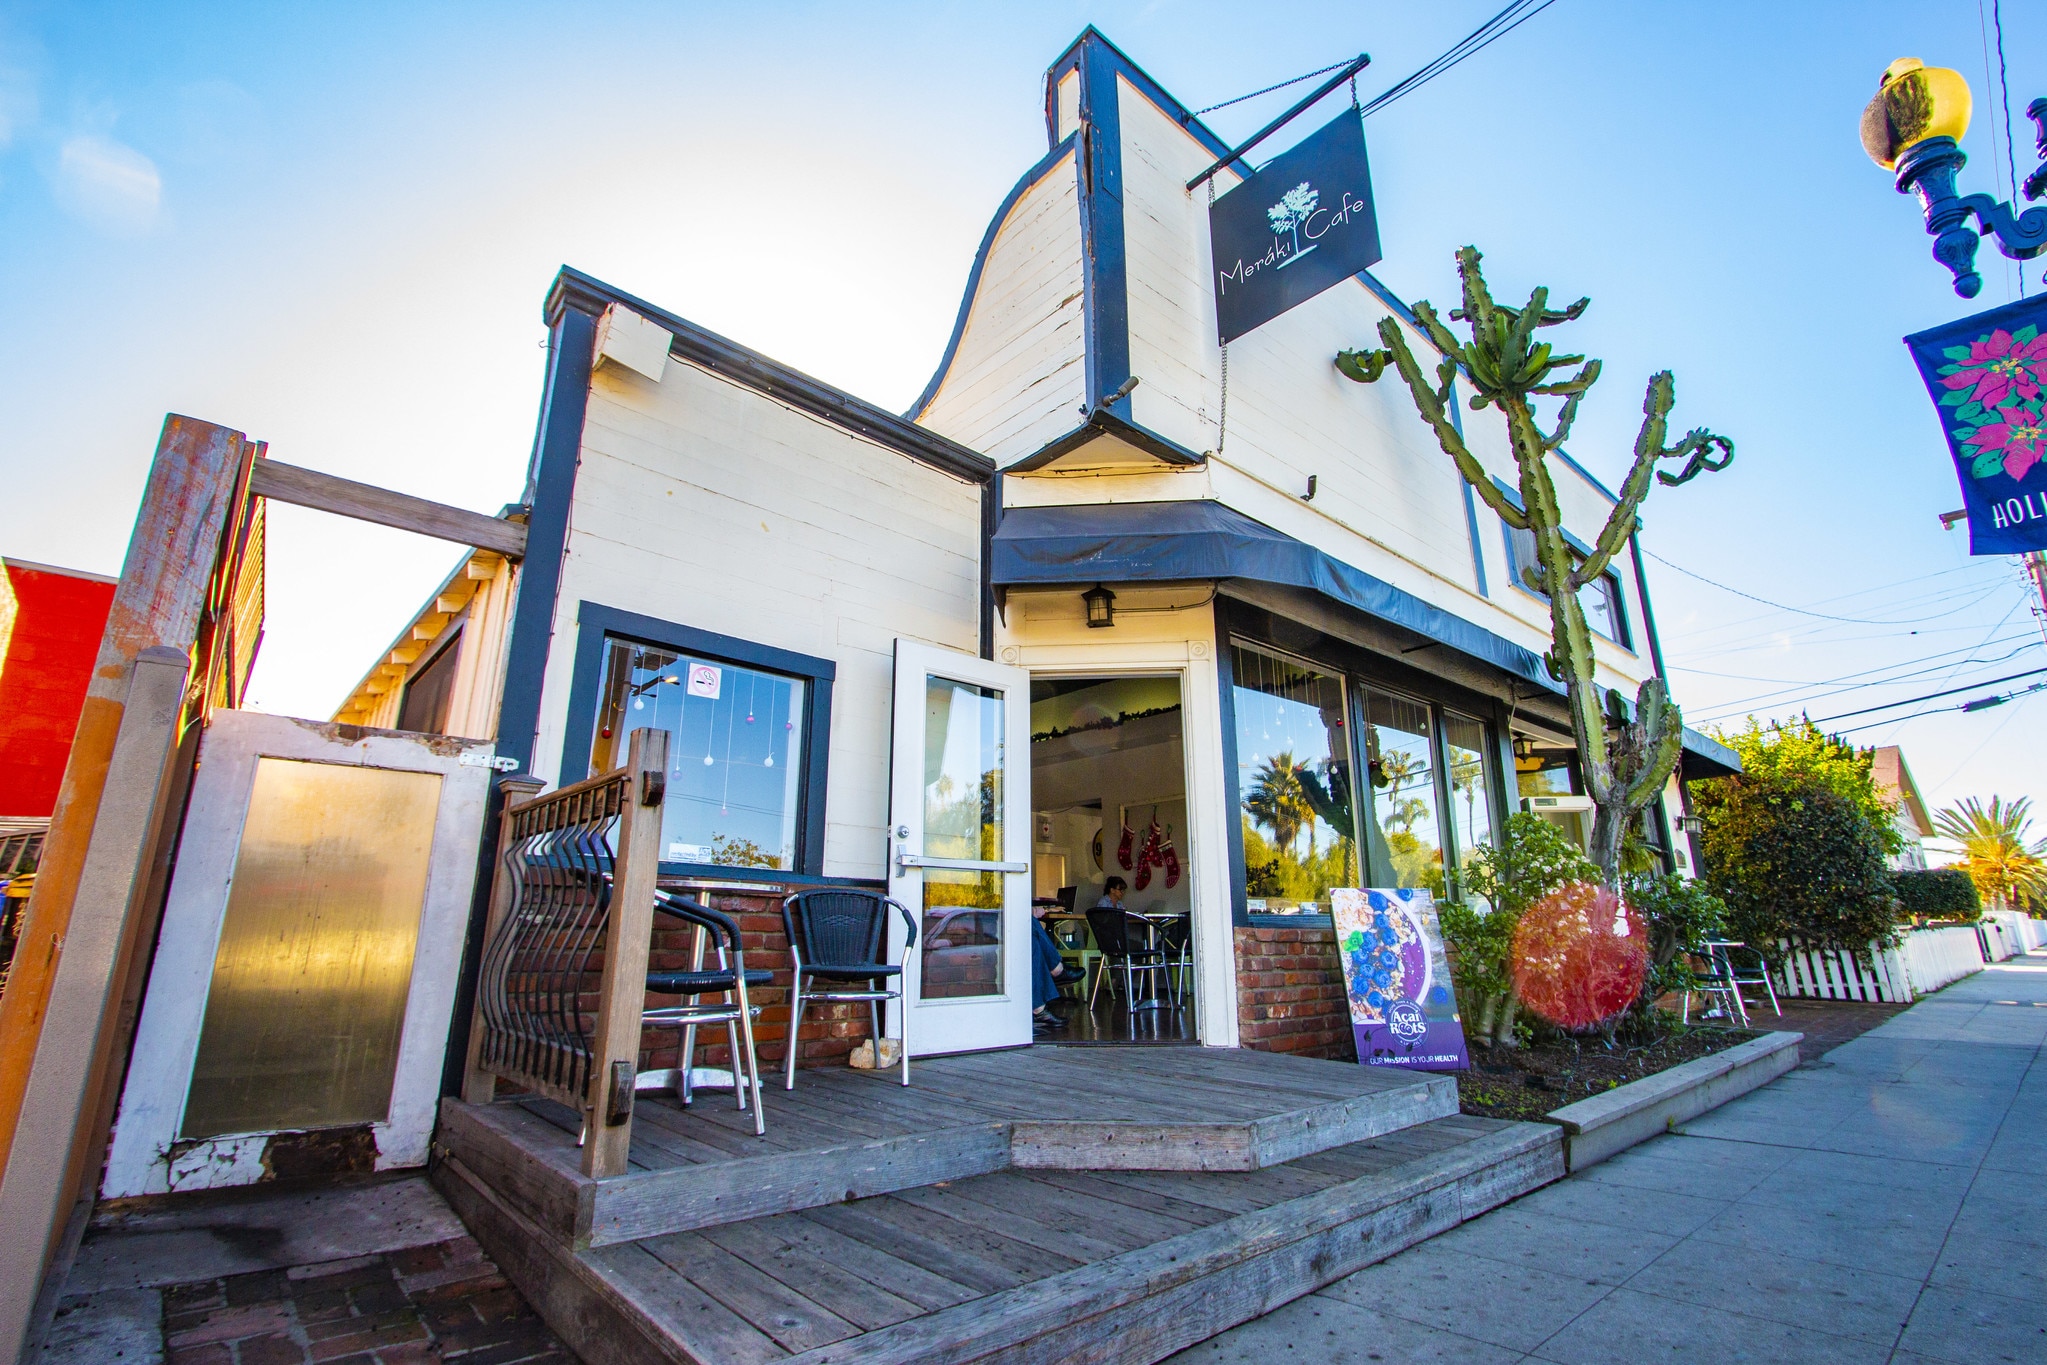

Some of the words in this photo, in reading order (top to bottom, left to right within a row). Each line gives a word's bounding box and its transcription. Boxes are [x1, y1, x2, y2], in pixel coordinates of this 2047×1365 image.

[1304, 192, 1364, 239] Cafe
[1370, 1057, 1383, 1065] OUR
[1384, 1056, 1410, 1064] MISSION
